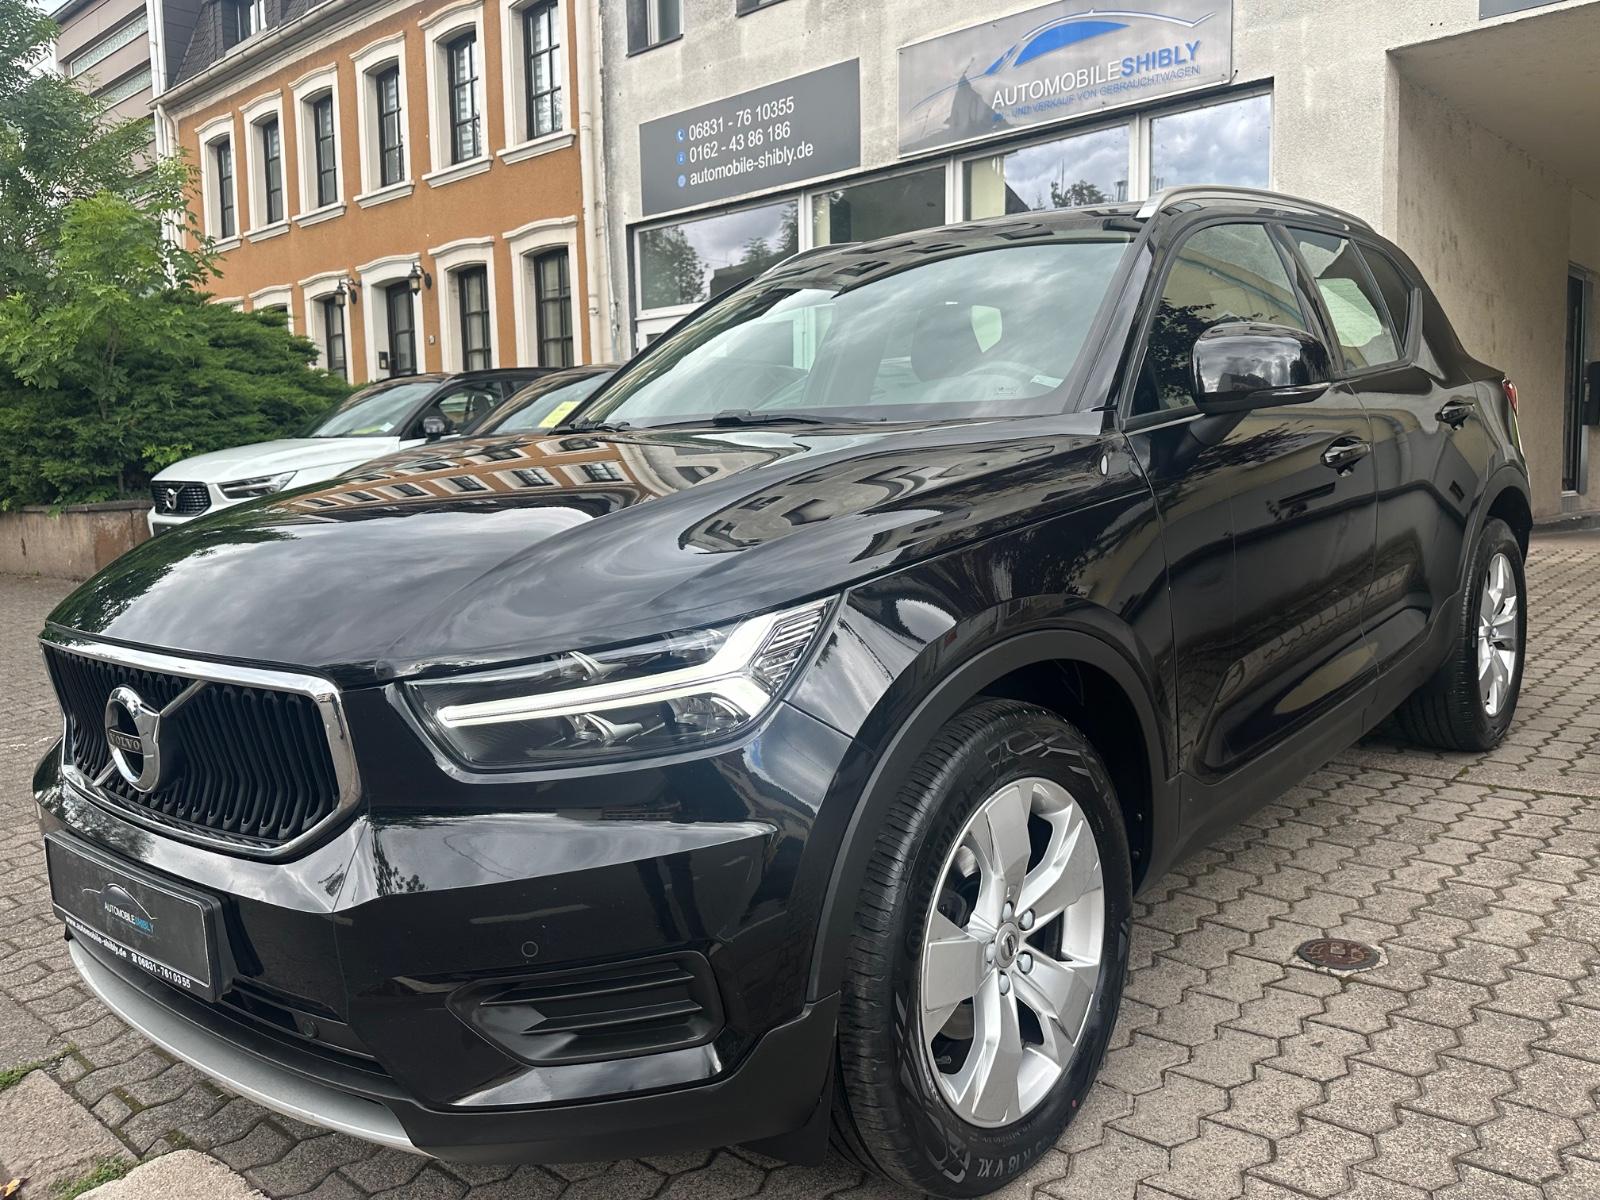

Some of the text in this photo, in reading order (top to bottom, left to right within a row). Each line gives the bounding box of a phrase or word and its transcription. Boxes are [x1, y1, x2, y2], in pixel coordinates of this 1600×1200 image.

[1077, 88, 1098, 102] VON
[1099, 65, 1201, 97] GEBRAUCHTWAGEN
[688, 117, 724, 142] 06831
[736, 109, 752, 128] 76
[755, 96, 795, 121] 10355
[689, 141, 718, 163] 0162
[729, 133, 744, 152] 43
[747, 128, 764, 147] 86
[767, 121, 791, 143] 186
[689, 142, 814, 185] automobile-shibly.de
[109, 732, 140, 750] VOLVO
